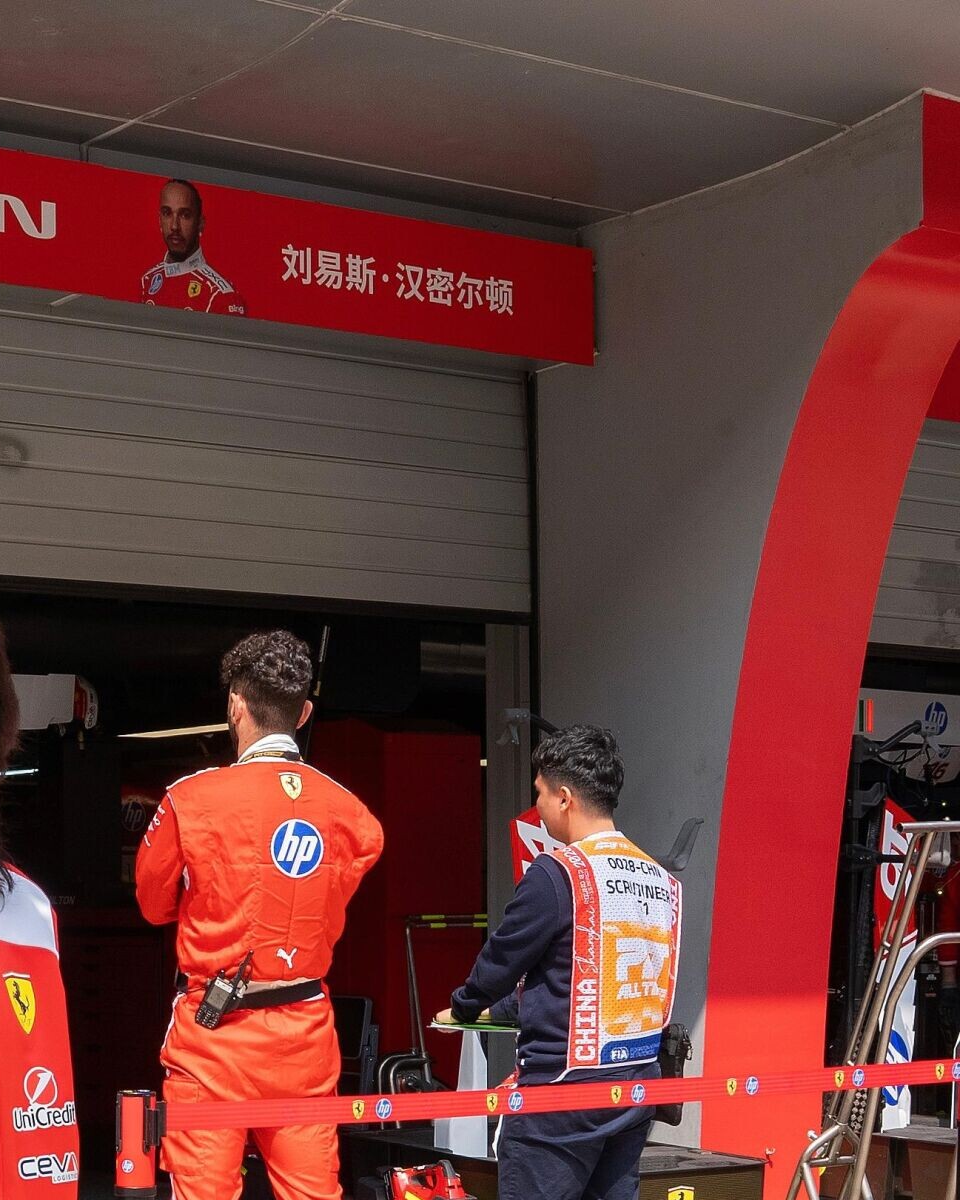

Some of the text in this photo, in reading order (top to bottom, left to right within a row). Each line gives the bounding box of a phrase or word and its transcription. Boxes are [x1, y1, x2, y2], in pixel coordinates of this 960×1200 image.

[281, 243, 514, 316] 刘易斯·汉密尔顿
[276, 820, 318, 877] hp
[574, 907, 601, 1062] CHINA Shanghai
[611, 1048, 628, 1061] FIA
[631, 1084, 645, 1103] hp
[746, 1076, 758, 1095] hp
[377, 1098, 392, 1119] hp
[509, 1091, 523, 1112] hp
[14, 1103, 76, 1130] UniCredit
